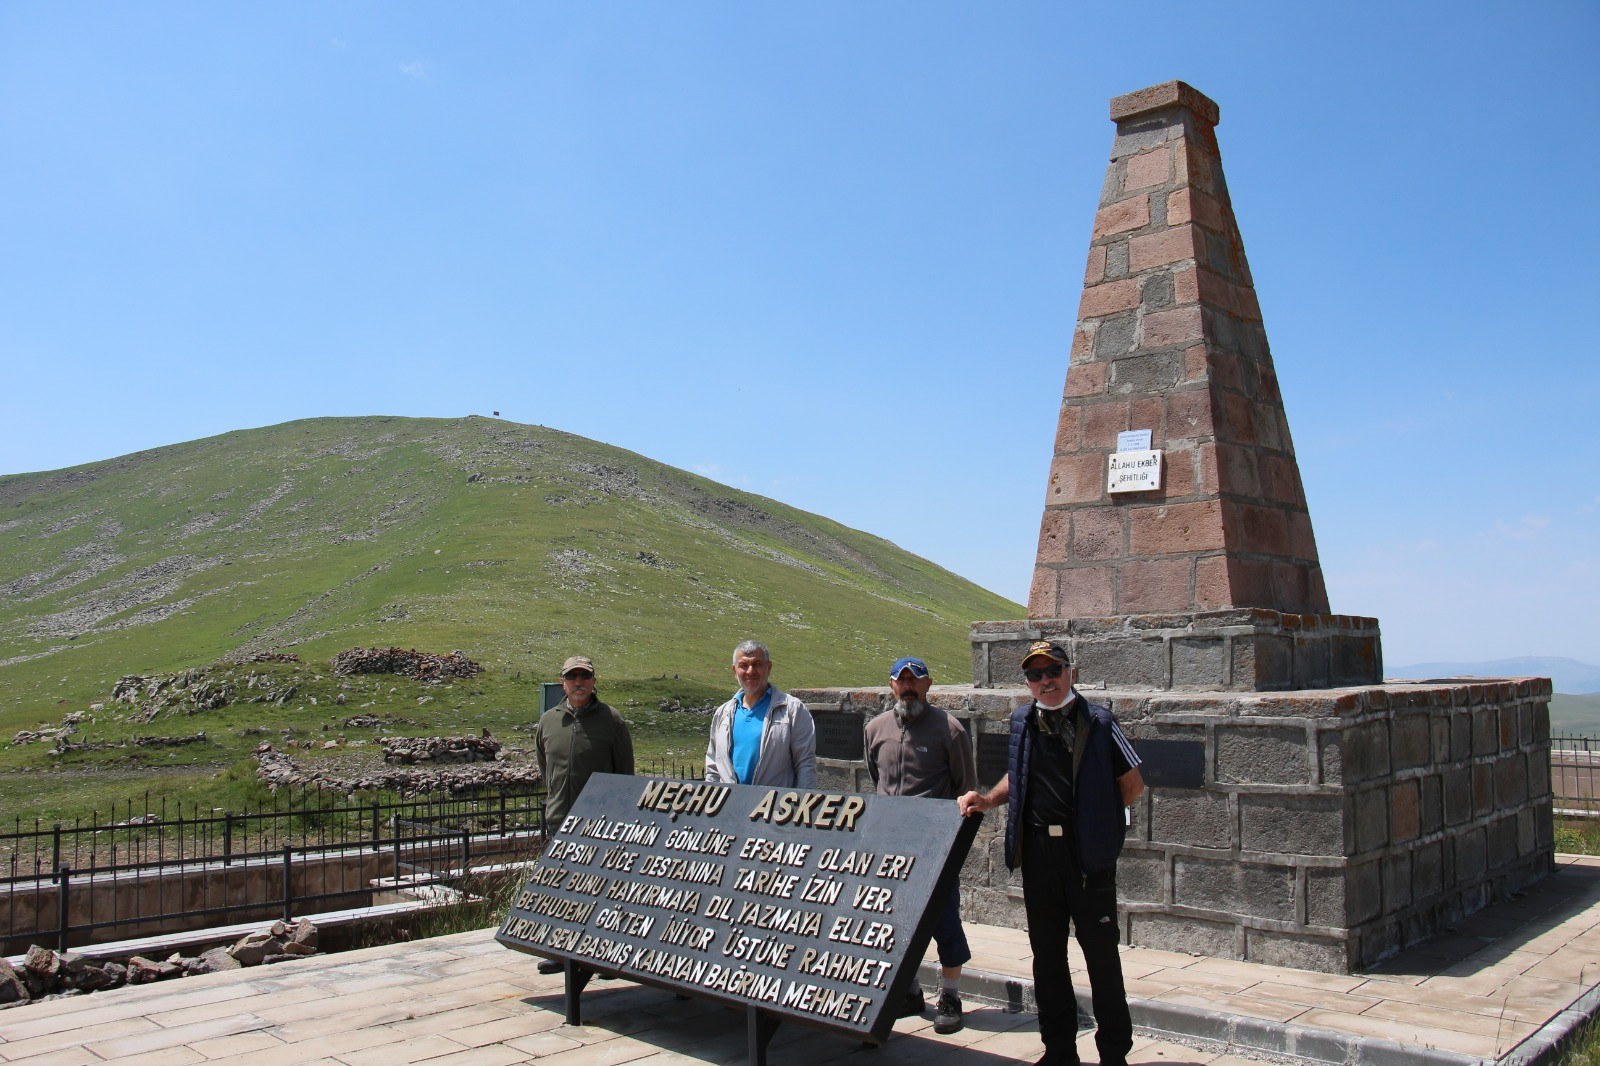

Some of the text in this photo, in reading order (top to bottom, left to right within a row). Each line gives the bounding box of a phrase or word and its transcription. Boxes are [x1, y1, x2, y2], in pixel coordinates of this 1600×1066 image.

[1111, 460, 1158, 470] ALLAHU EKBER
[559, 815, 916, 881] EY MİLLETİMİN GÖNLÜNE EFSANE OLAN ER!
[749, 789, 865, 833] ASKER
[530, 862, 569, 889] ACİZ
[565, 871, 608, 897] BUNU
[605, 879, 702, 914] HAYKIRMAYA
[828, 915, 895, 951] ELLER;
[547, 839, 893, 914] TAPSIN YÜCE DESTANINA TARİHE İZİN VER.
[501, 914, 875, 1025] YURDUN SENİ BASMIŞ KANAYAN BAĞRINA MEHMET.
[515, 889, 894, 990] BEYHUDEMİ GÖKTEN İNİYOR ÜSTÜNE RAHMET.
